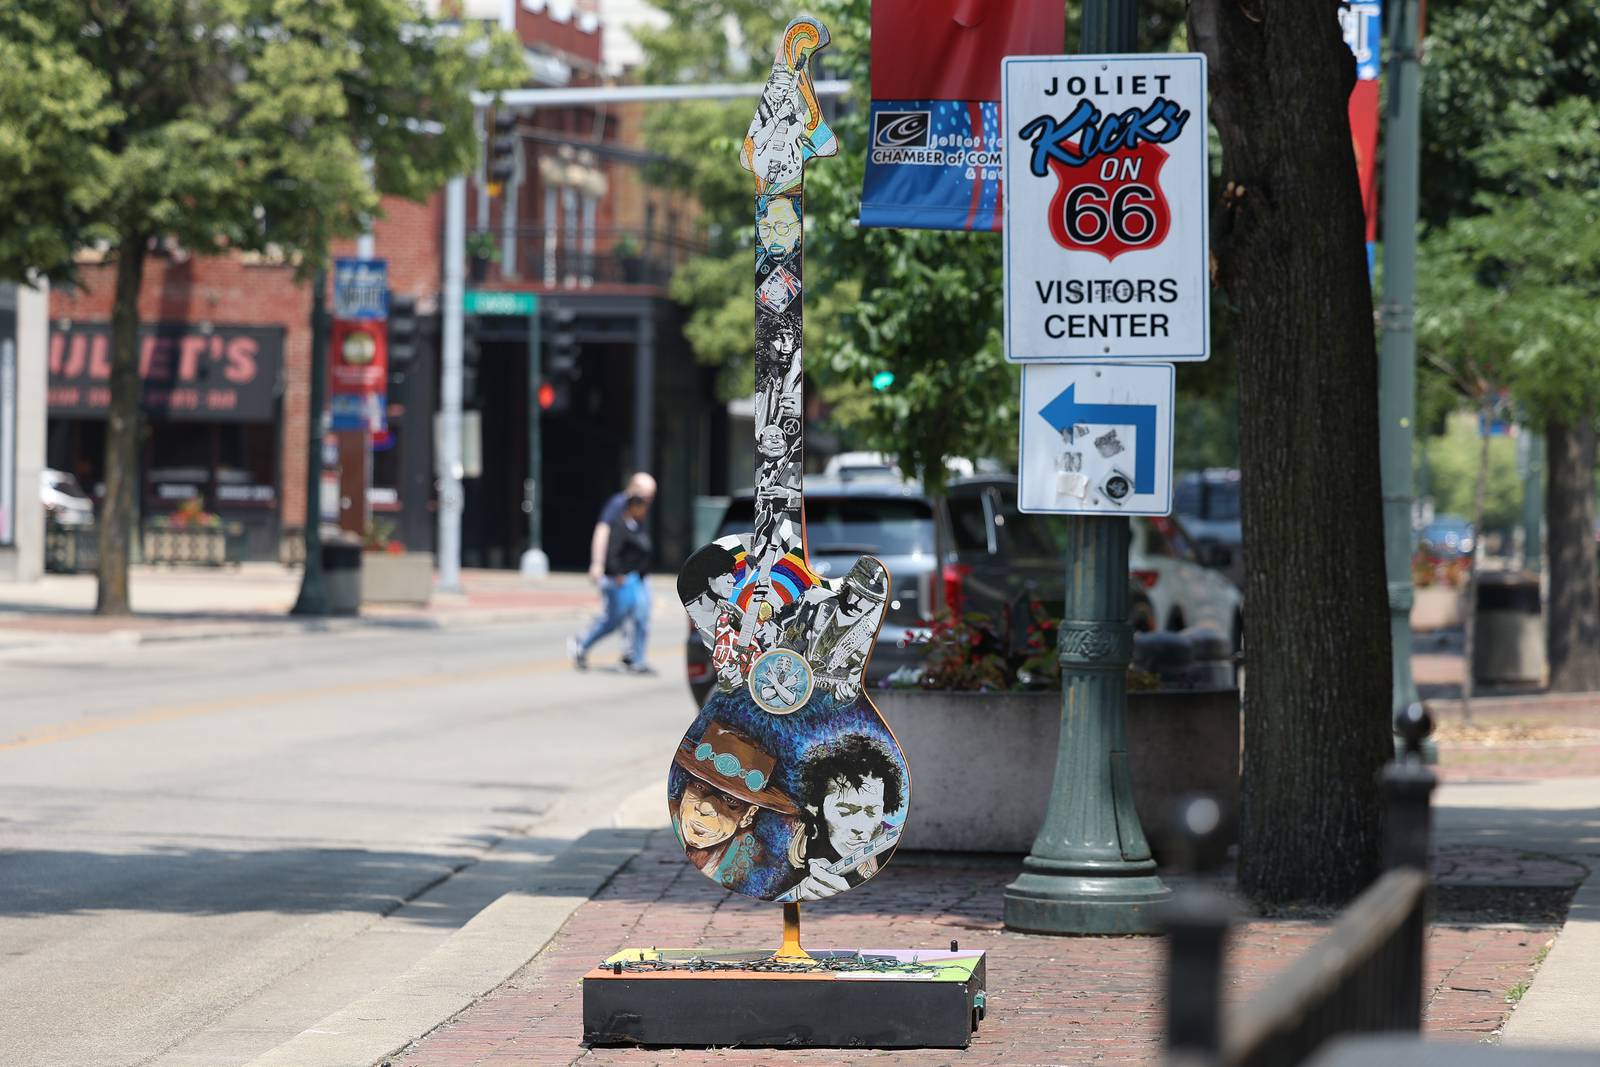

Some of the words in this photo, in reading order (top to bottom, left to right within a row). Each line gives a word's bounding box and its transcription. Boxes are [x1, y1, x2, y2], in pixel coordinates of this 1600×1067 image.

[1044, 75, 1171, 96] JOLIET
[872, 151, 945, 164] CHAMBER
[947, 151, 964, 167] of
[967, 151, 1003, 166] COM
[1100, 157, 1142, 181] ON
[1063, 183, 1156, 245] 66
[1036, 278, 1178, 304] VISITORS
[1044, 313, 1169, 339] CENTER
